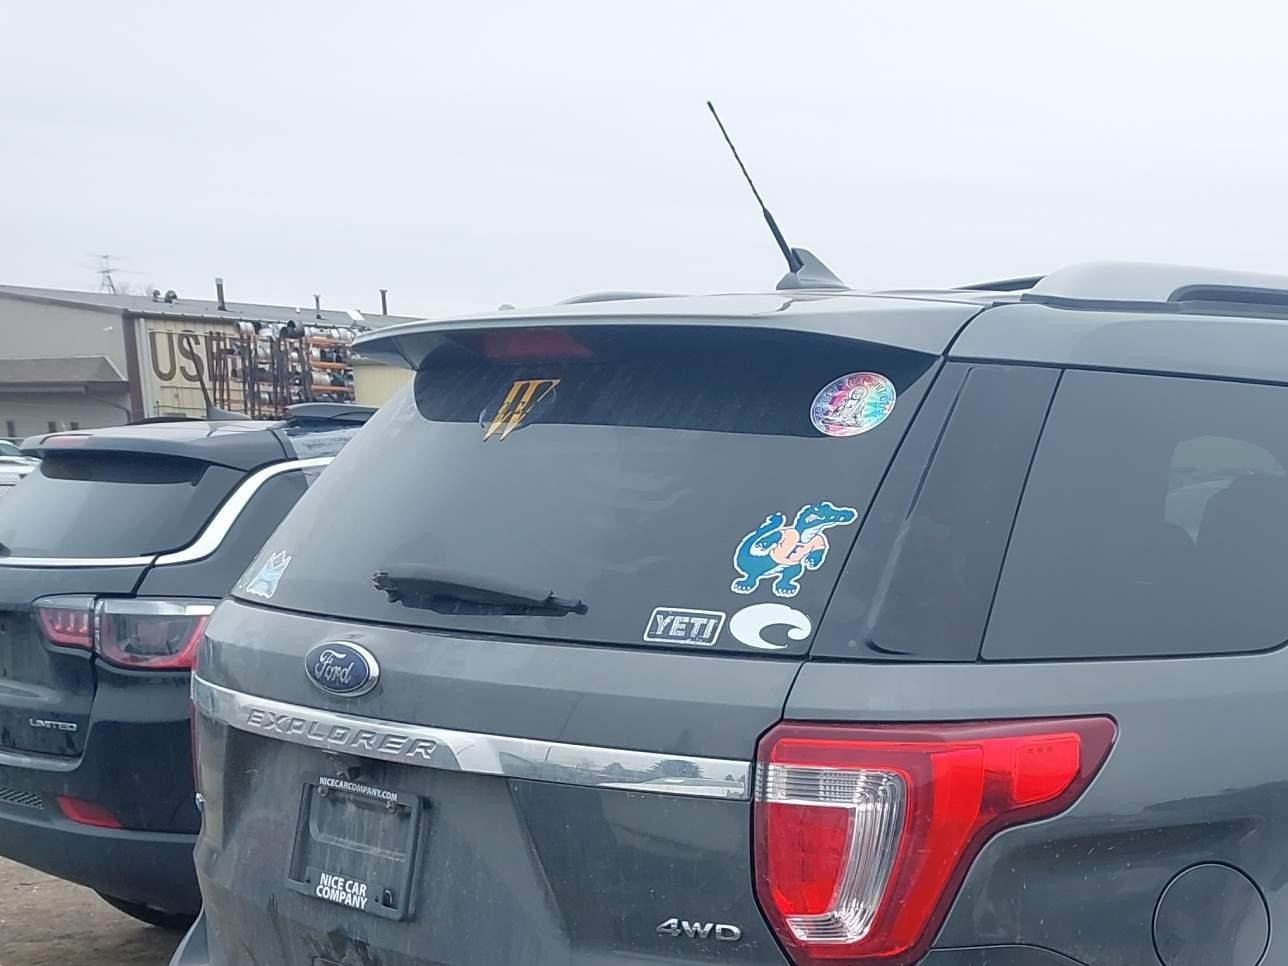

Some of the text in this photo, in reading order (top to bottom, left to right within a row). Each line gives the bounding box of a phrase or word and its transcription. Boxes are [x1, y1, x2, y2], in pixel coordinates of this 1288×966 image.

[656, 614, 715, 639] YETI
[315, 649, 354, 684] Ford
[247, 708, 438, 759] EXPLORER
[319, 777, 398, 801] NICECARCOMPANY.COM
[320, 872, 367, 897] NICE CAR
[316, 885, 368, 910] COMPANY
[656, 918, 741, 941] 4WD
